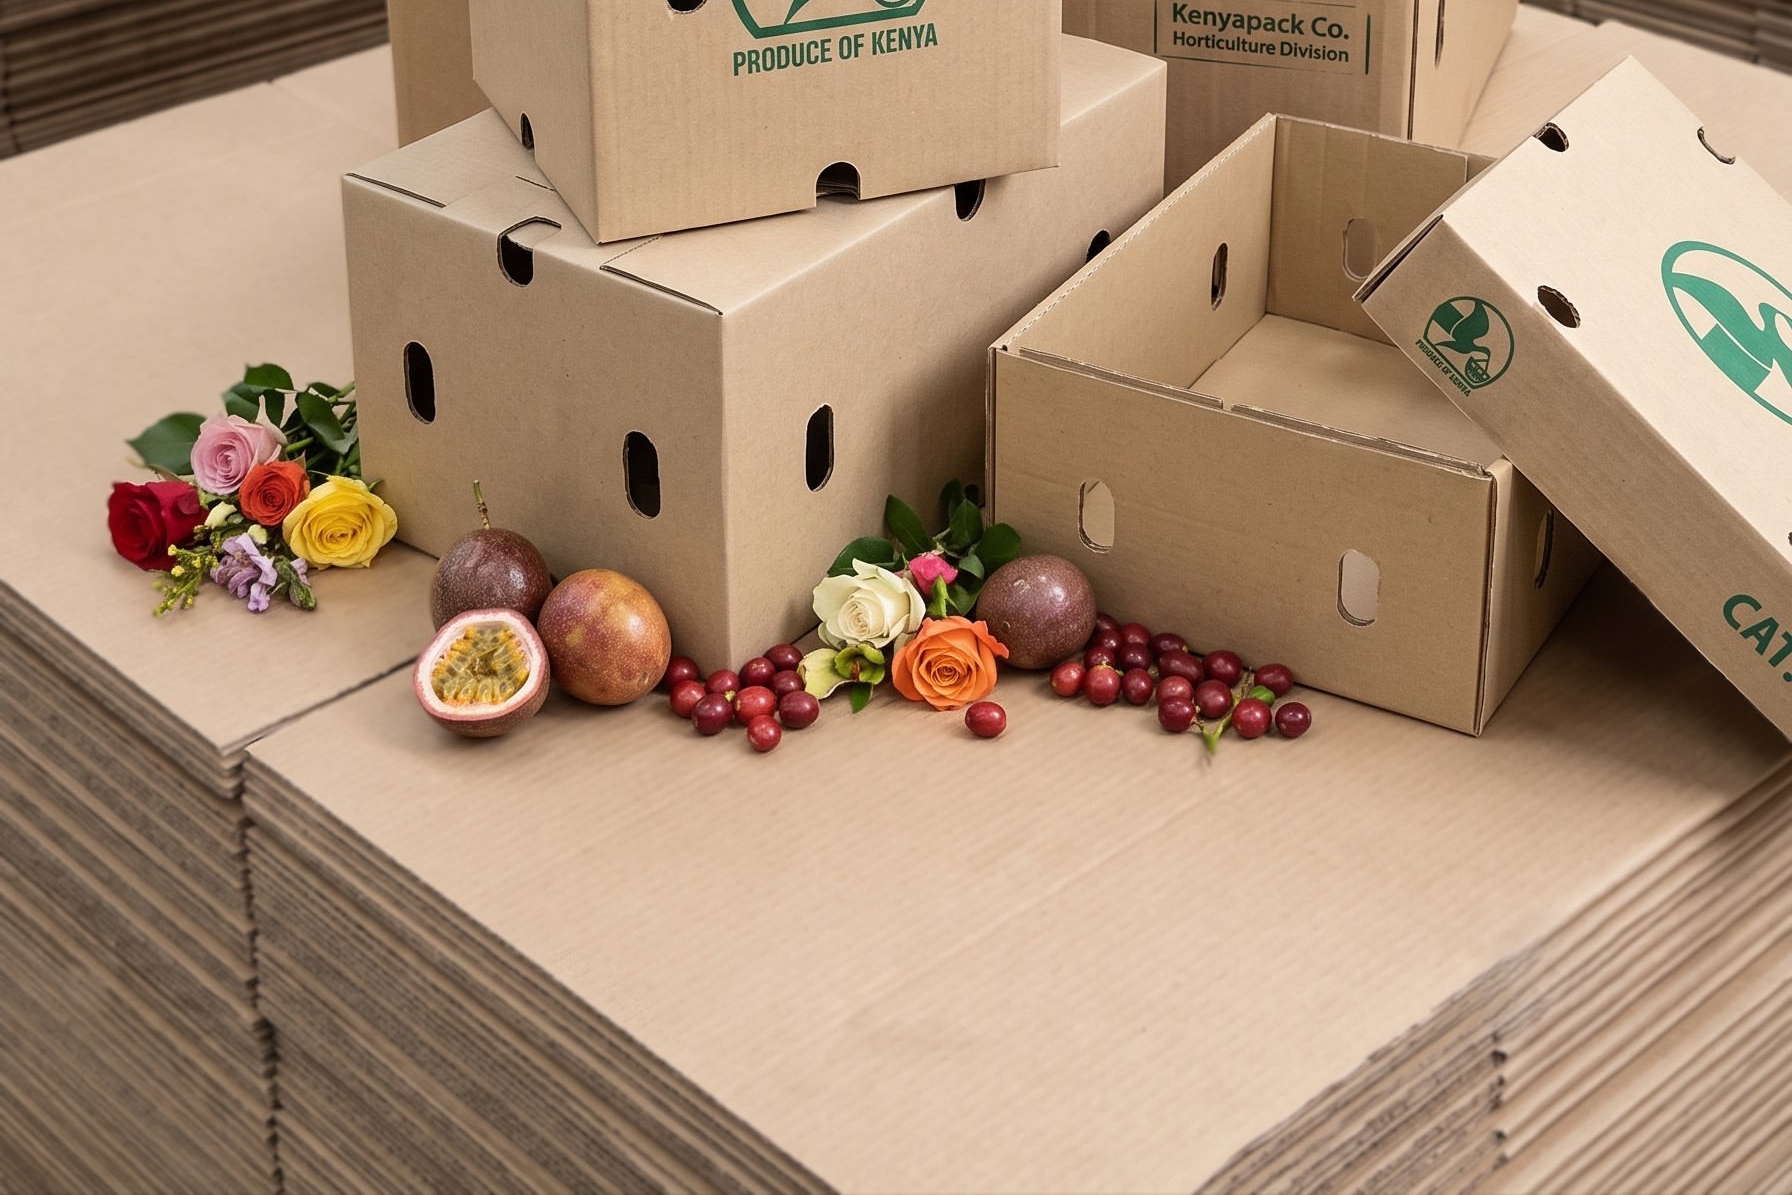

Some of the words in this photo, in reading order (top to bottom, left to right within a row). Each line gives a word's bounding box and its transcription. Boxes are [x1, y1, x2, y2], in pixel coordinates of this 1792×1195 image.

[1172, 2, 1304, 35] Kenyapack
[1311, 16, 1350, 40] Co.
[733, 38, 832, 76] PRODUCE
[838, 33, 864, 60] OF
[871, 22, 938, 55] KENYA
[1173, 31, 1276, 55] Horticulture
[1280, 41, 1349, 62] Division
